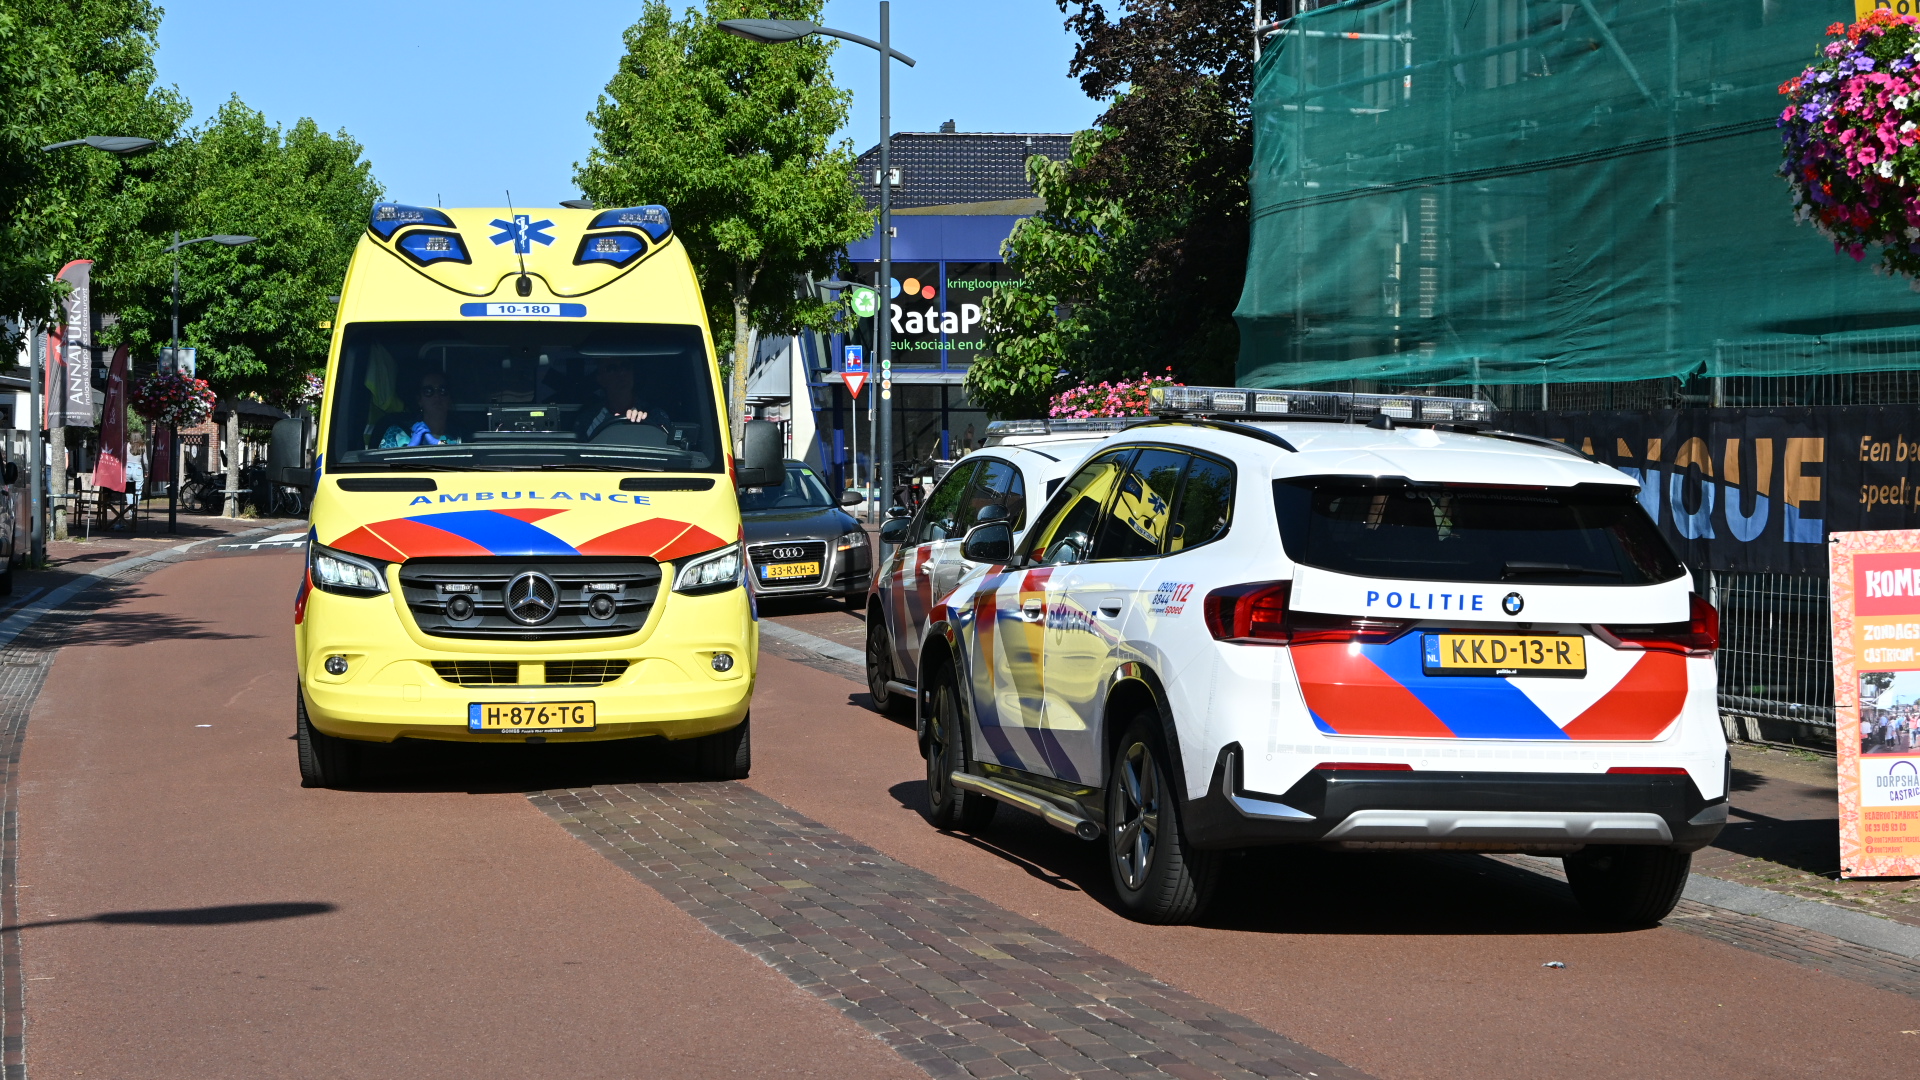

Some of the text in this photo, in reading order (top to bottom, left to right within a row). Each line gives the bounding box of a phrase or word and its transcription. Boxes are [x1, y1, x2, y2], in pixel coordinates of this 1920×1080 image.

[947, 278, 1034, 292] kringloopwink
[498, 305, 551, 315] 10-180
[67, 286, 84, 405] ANNAPURNA
[890, 339, 913, 352] euk,
[914, 338, 955, 350] sociaal
[957, 342, 972, 350] en
[1859, 435, 1891, 461] Een
[409, 490, 651, 506] AMBULANCE
[1859, 476, 1911, 512] speelt
[770, 564, 816, 576] 33-RXH-3
[1157, 582, 1177, 592] 0900
[1171, 583, 1194, 602] 112
[1152, 594, 1170, 605] 8844
[1366, 590, 1484, 611] POLITIE
[1164, 604, 1185, 616] spoed
[1427, 654, 1438, 663] NL
[1452, 639, 1572, 665] KKD-13-R
[487, 706, 585, 726] H-876-TG
[1876, 775, 1920, 788] DORPSHA
